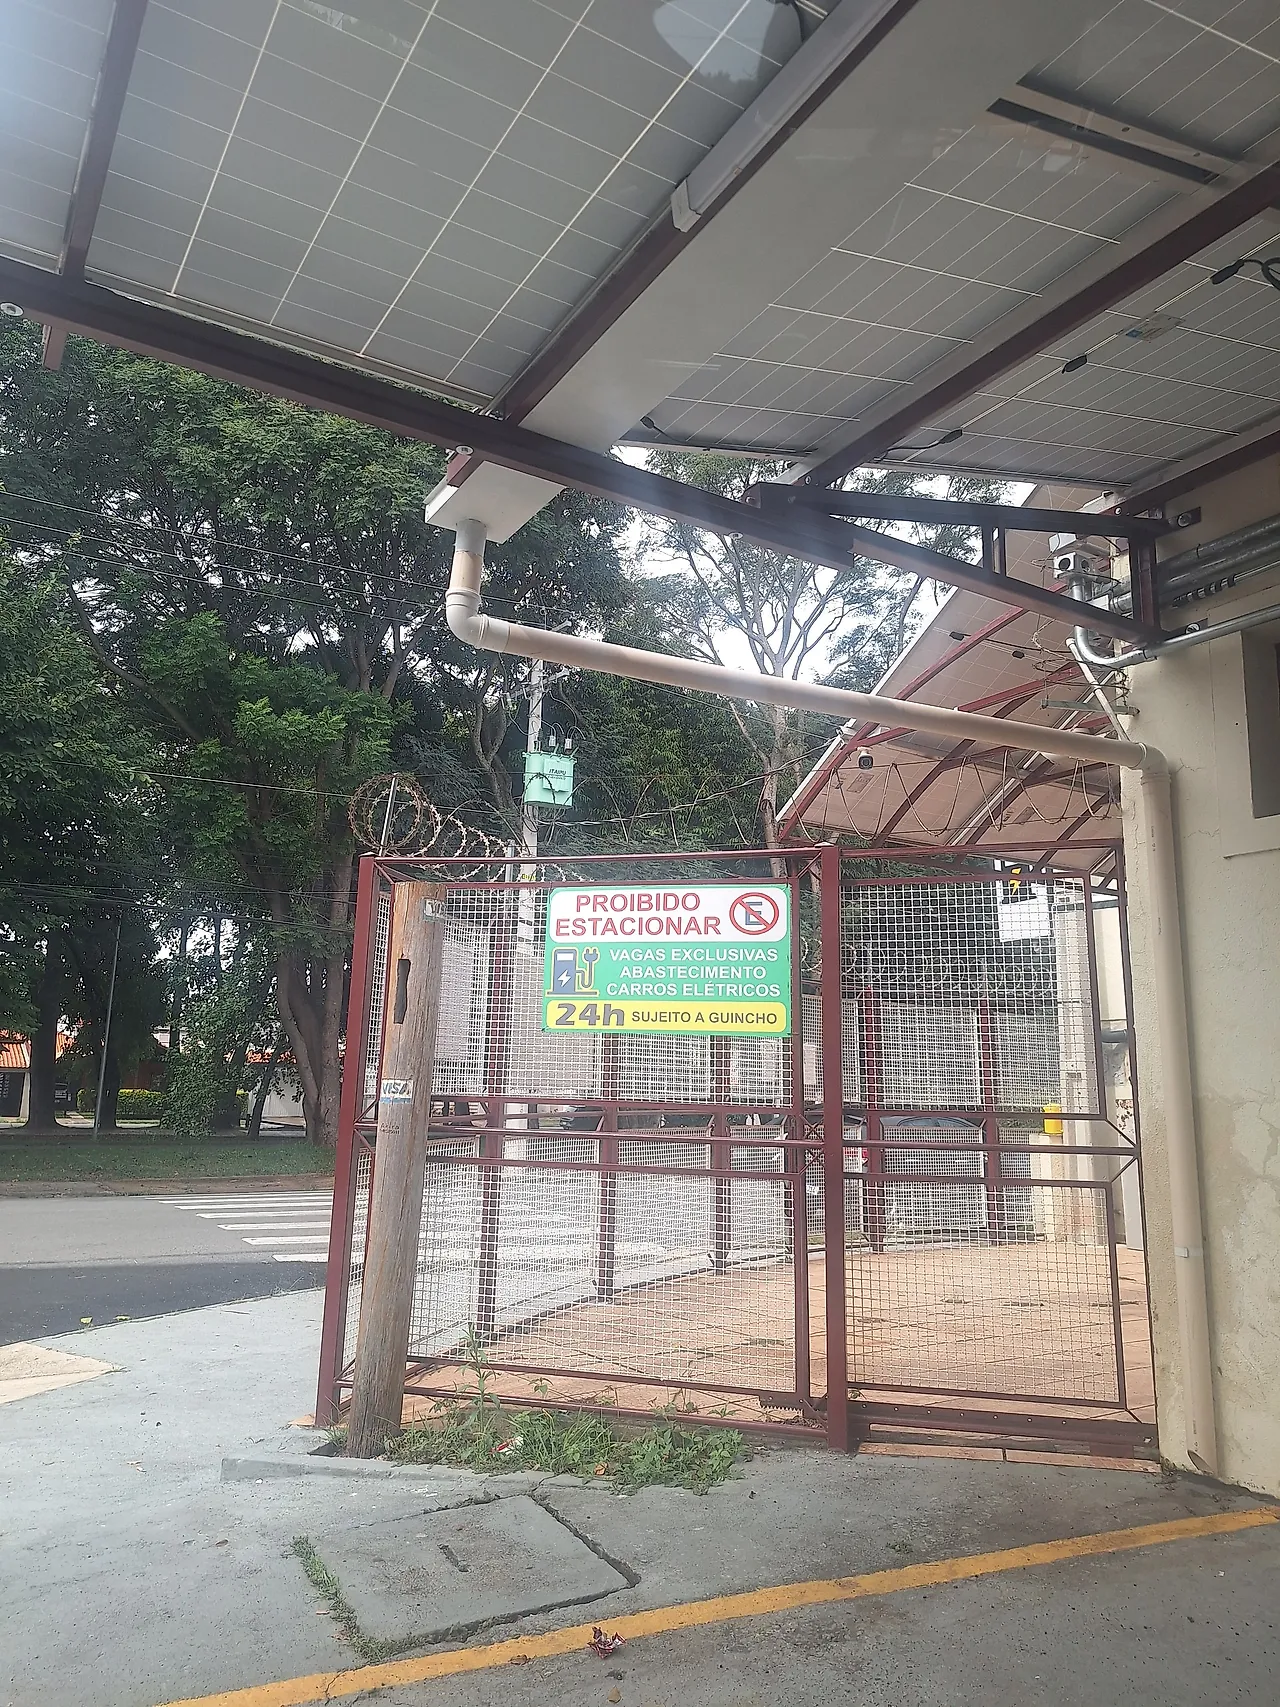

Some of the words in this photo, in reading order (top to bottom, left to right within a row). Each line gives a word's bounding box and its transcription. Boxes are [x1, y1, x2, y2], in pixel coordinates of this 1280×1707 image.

[576, 893, 700, 912] PROIBIDO
[555, 917, 722, 936] ESTACIONAR
[609, 949, 666, 961] VAGAS
[671, 949, 778, 962] EXCLUSIVAS
[619, 966, 767, 979] ABASTECIMENTO
[606, 983, 678, 996] CARROS
[682, 981, 781, 997] ELÉTRICOS
[556, 1003, 625, 1026] 24h
[631, 1011, 691, 1023] SUJEITO
[694, 1012, 705, 1023] A
[708, 1012, 778, 1024] GUINCHO
